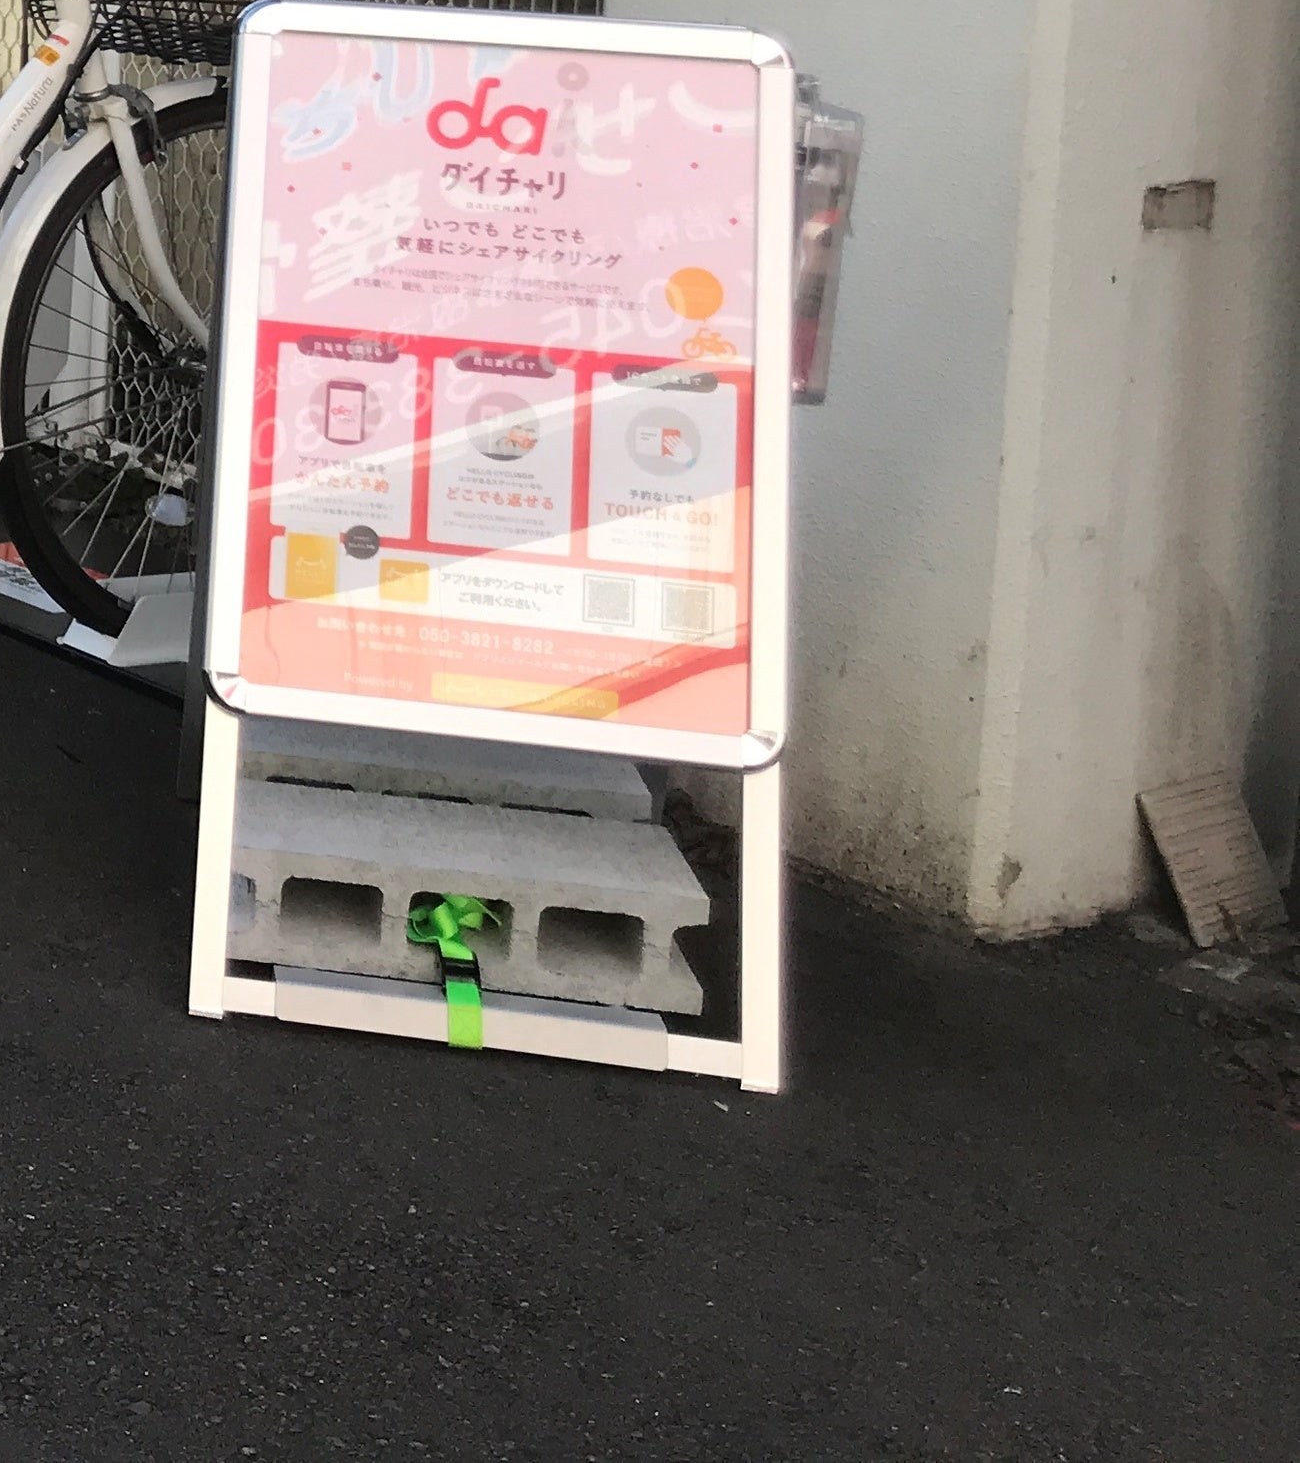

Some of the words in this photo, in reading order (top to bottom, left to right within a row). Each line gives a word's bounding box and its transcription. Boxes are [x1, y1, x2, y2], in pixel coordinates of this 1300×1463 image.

[441, 162, 566, 200] ダイチャリ
[423, 219, 499, 237] いつでも
[512, 225, 585, 244] どこでも
[396, 236, 622, 269] 気軽にシェアサイクリング
